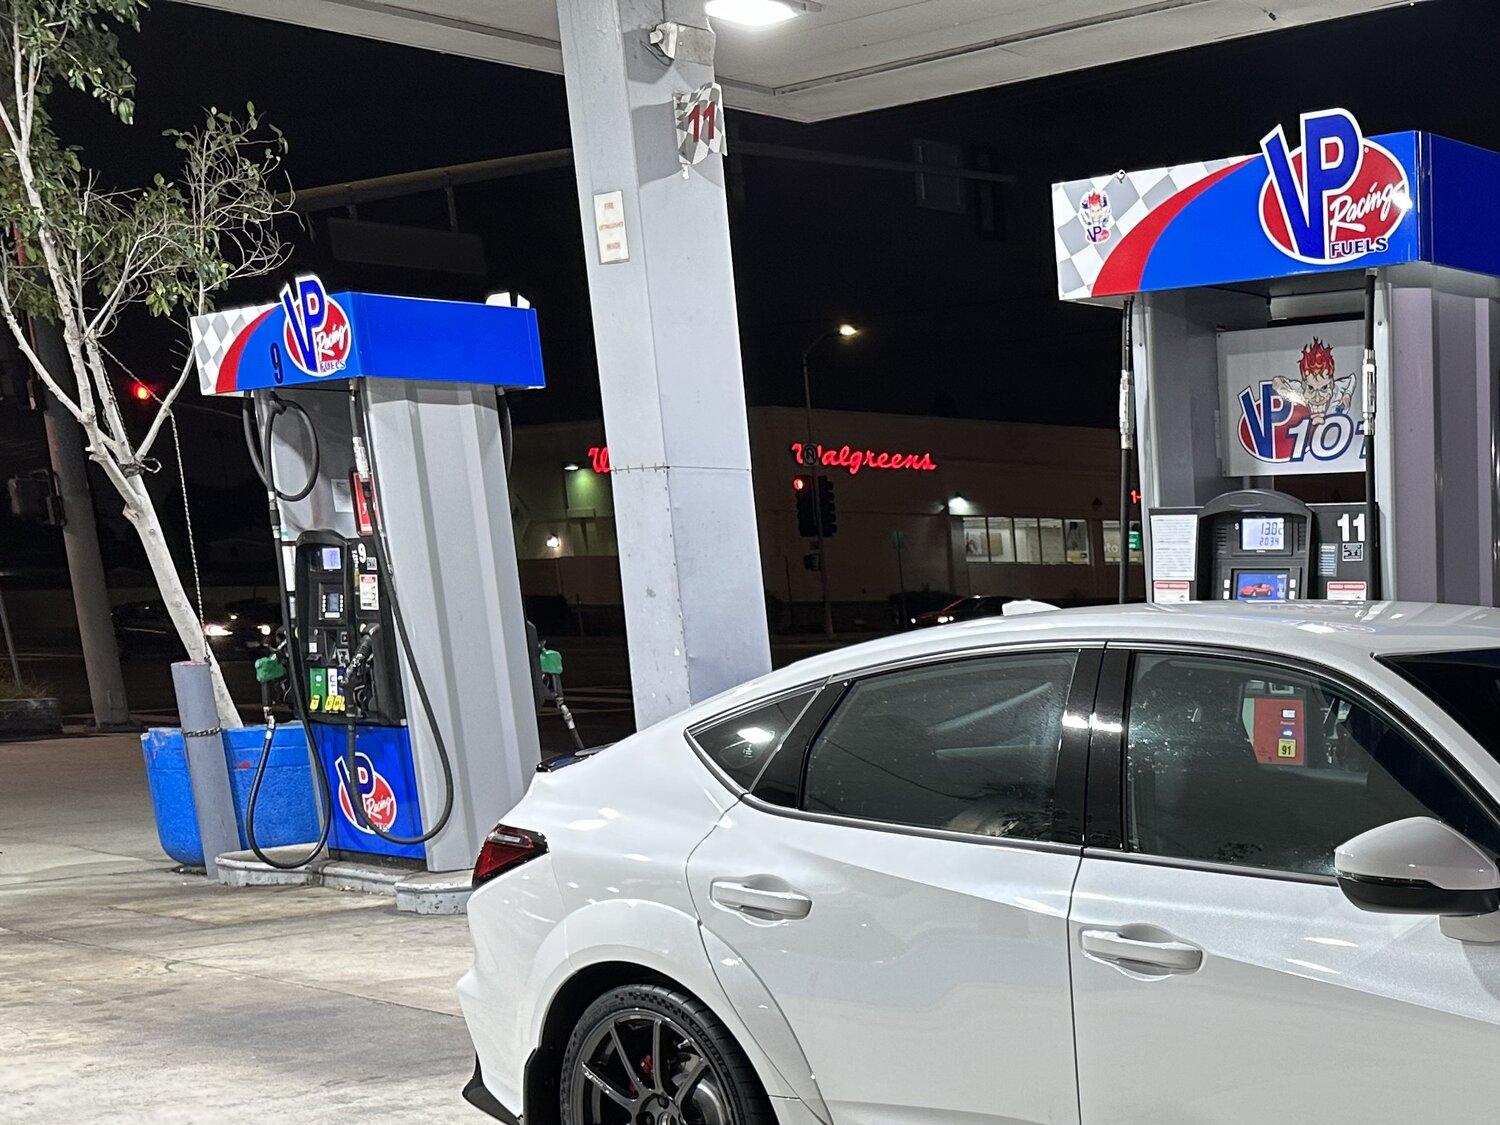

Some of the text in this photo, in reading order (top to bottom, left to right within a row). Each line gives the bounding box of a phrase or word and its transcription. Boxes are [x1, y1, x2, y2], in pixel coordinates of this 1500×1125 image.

[688, 101, 716, 143] 11
[1262, 112, 1361, 260] VP
[1330, 181, 1408, 241] Racing
[1086, 226, 1102, 243] VP
[1330, 237, 1389, 259] FUELS
[282, 278, 326, 373] VP
[316, 322, 348, 361] Racing
[270, 343, 284, 384] 9
[1239, 379, 1295, 460] VP
[1337, 513, 1366, 542] 11
[357, 543, 367, 563] 9
[1281, 745, 1291, 756] 91
